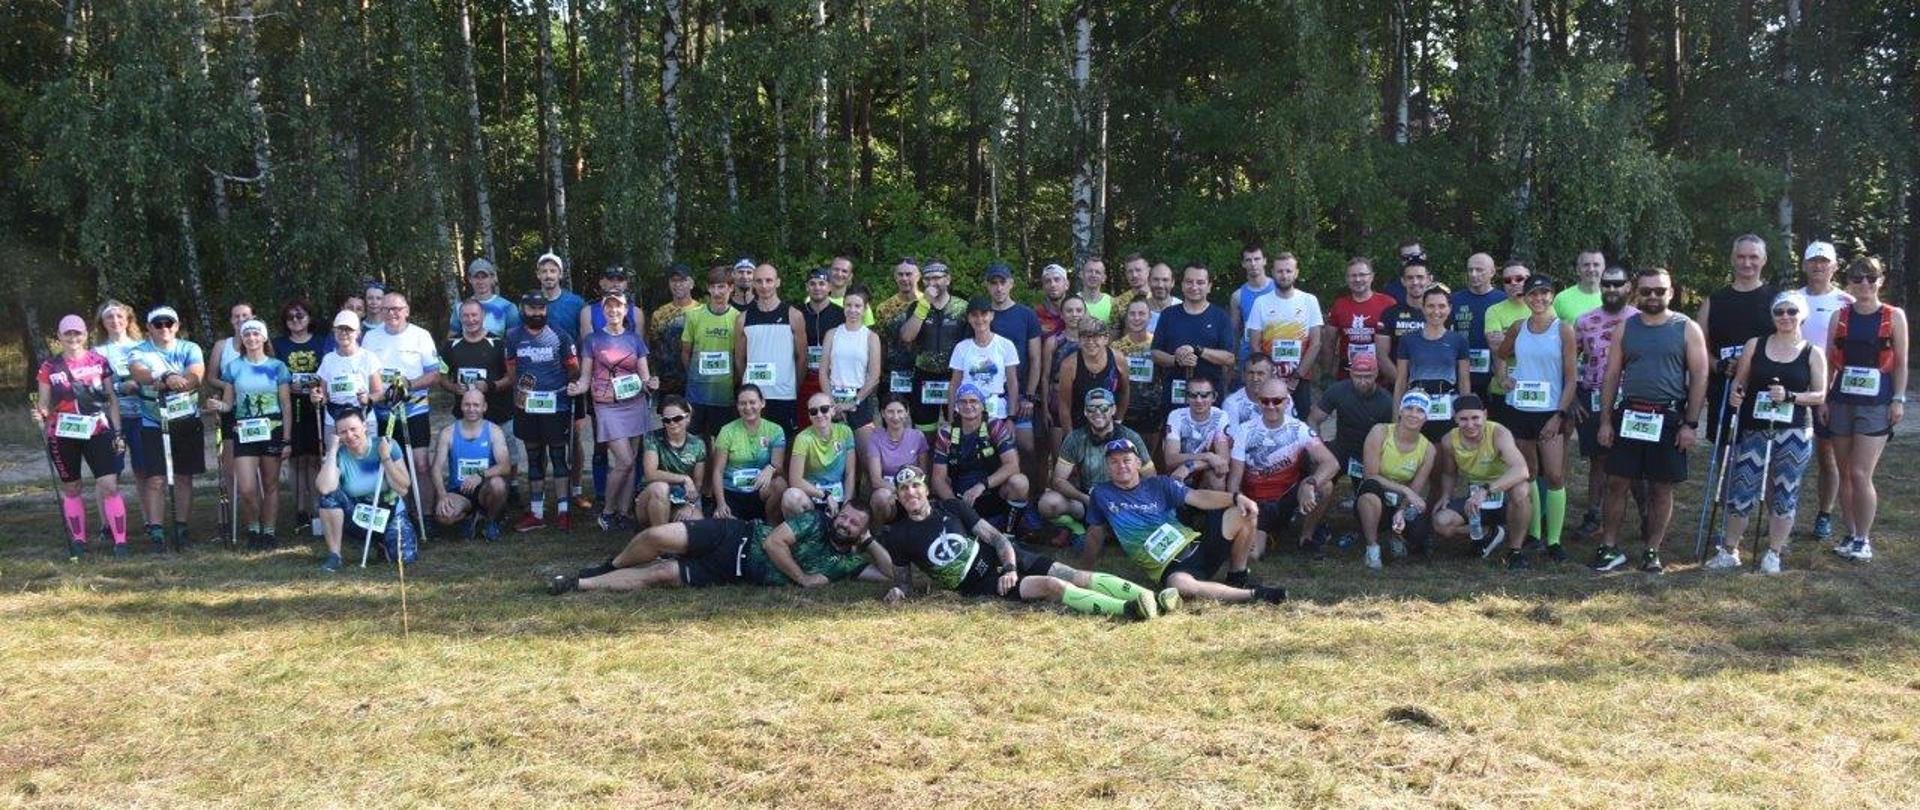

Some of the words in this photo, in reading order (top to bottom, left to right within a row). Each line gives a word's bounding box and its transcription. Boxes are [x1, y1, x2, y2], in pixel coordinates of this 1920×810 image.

[1850, 377, 1866, 387] 42
[1522, 391, 1538, 401] 83
[64, 422, 80, 433] 73
[1632, 422, 1649, 433] 45
